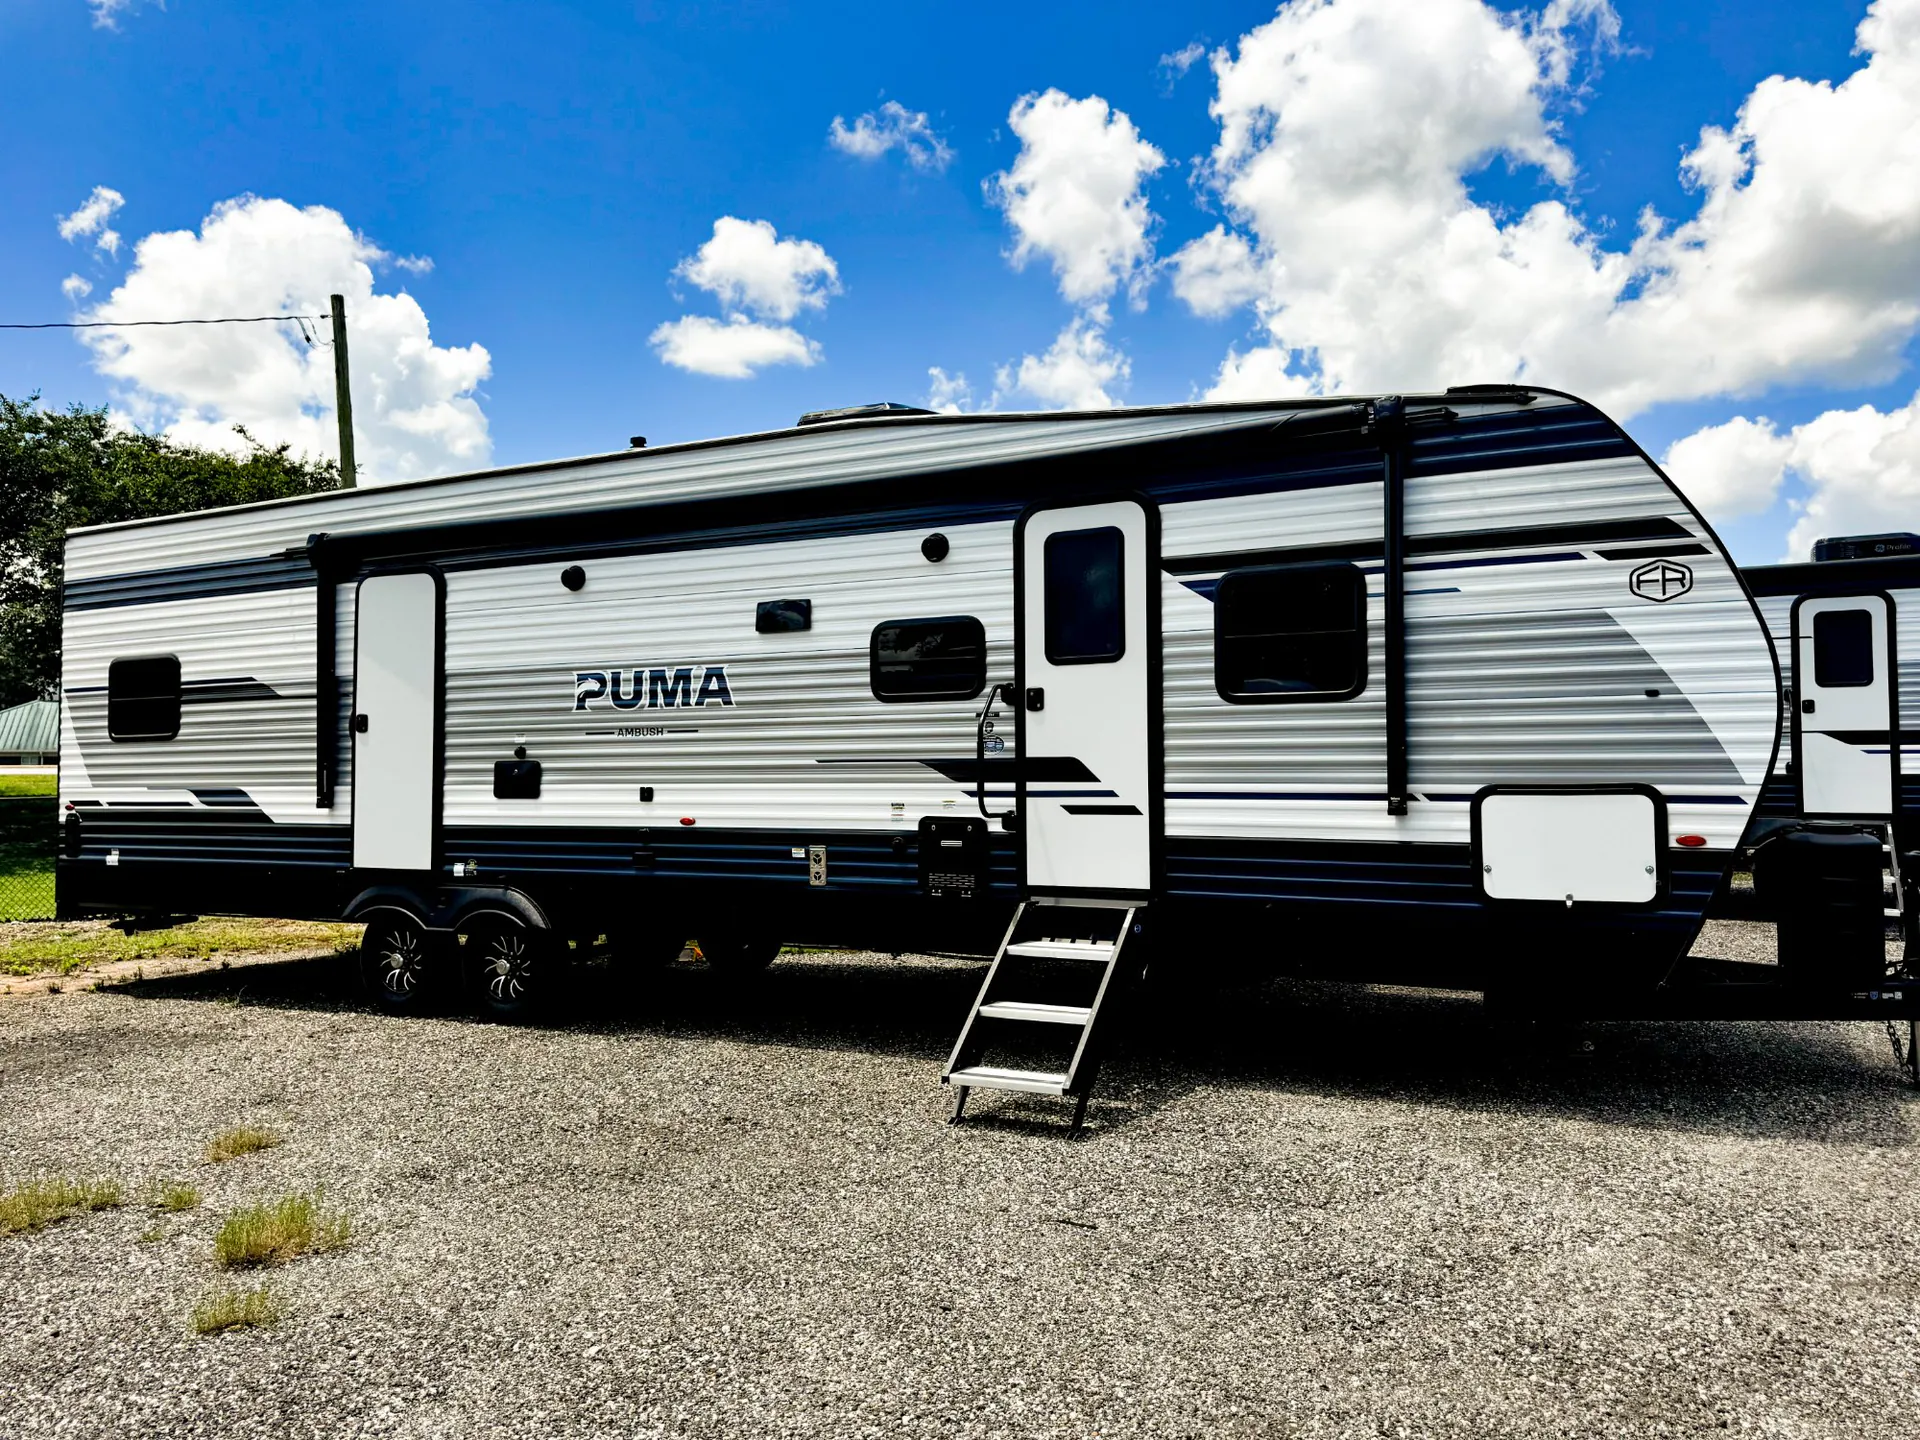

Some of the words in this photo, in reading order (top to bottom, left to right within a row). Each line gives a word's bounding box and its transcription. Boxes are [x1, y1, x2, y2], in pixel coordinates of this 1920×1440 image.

[1636, 565, 1686, 597] FR
[572, 664, 737, 712] PUMA
[617, 727, 664, 737] AMBUSH
